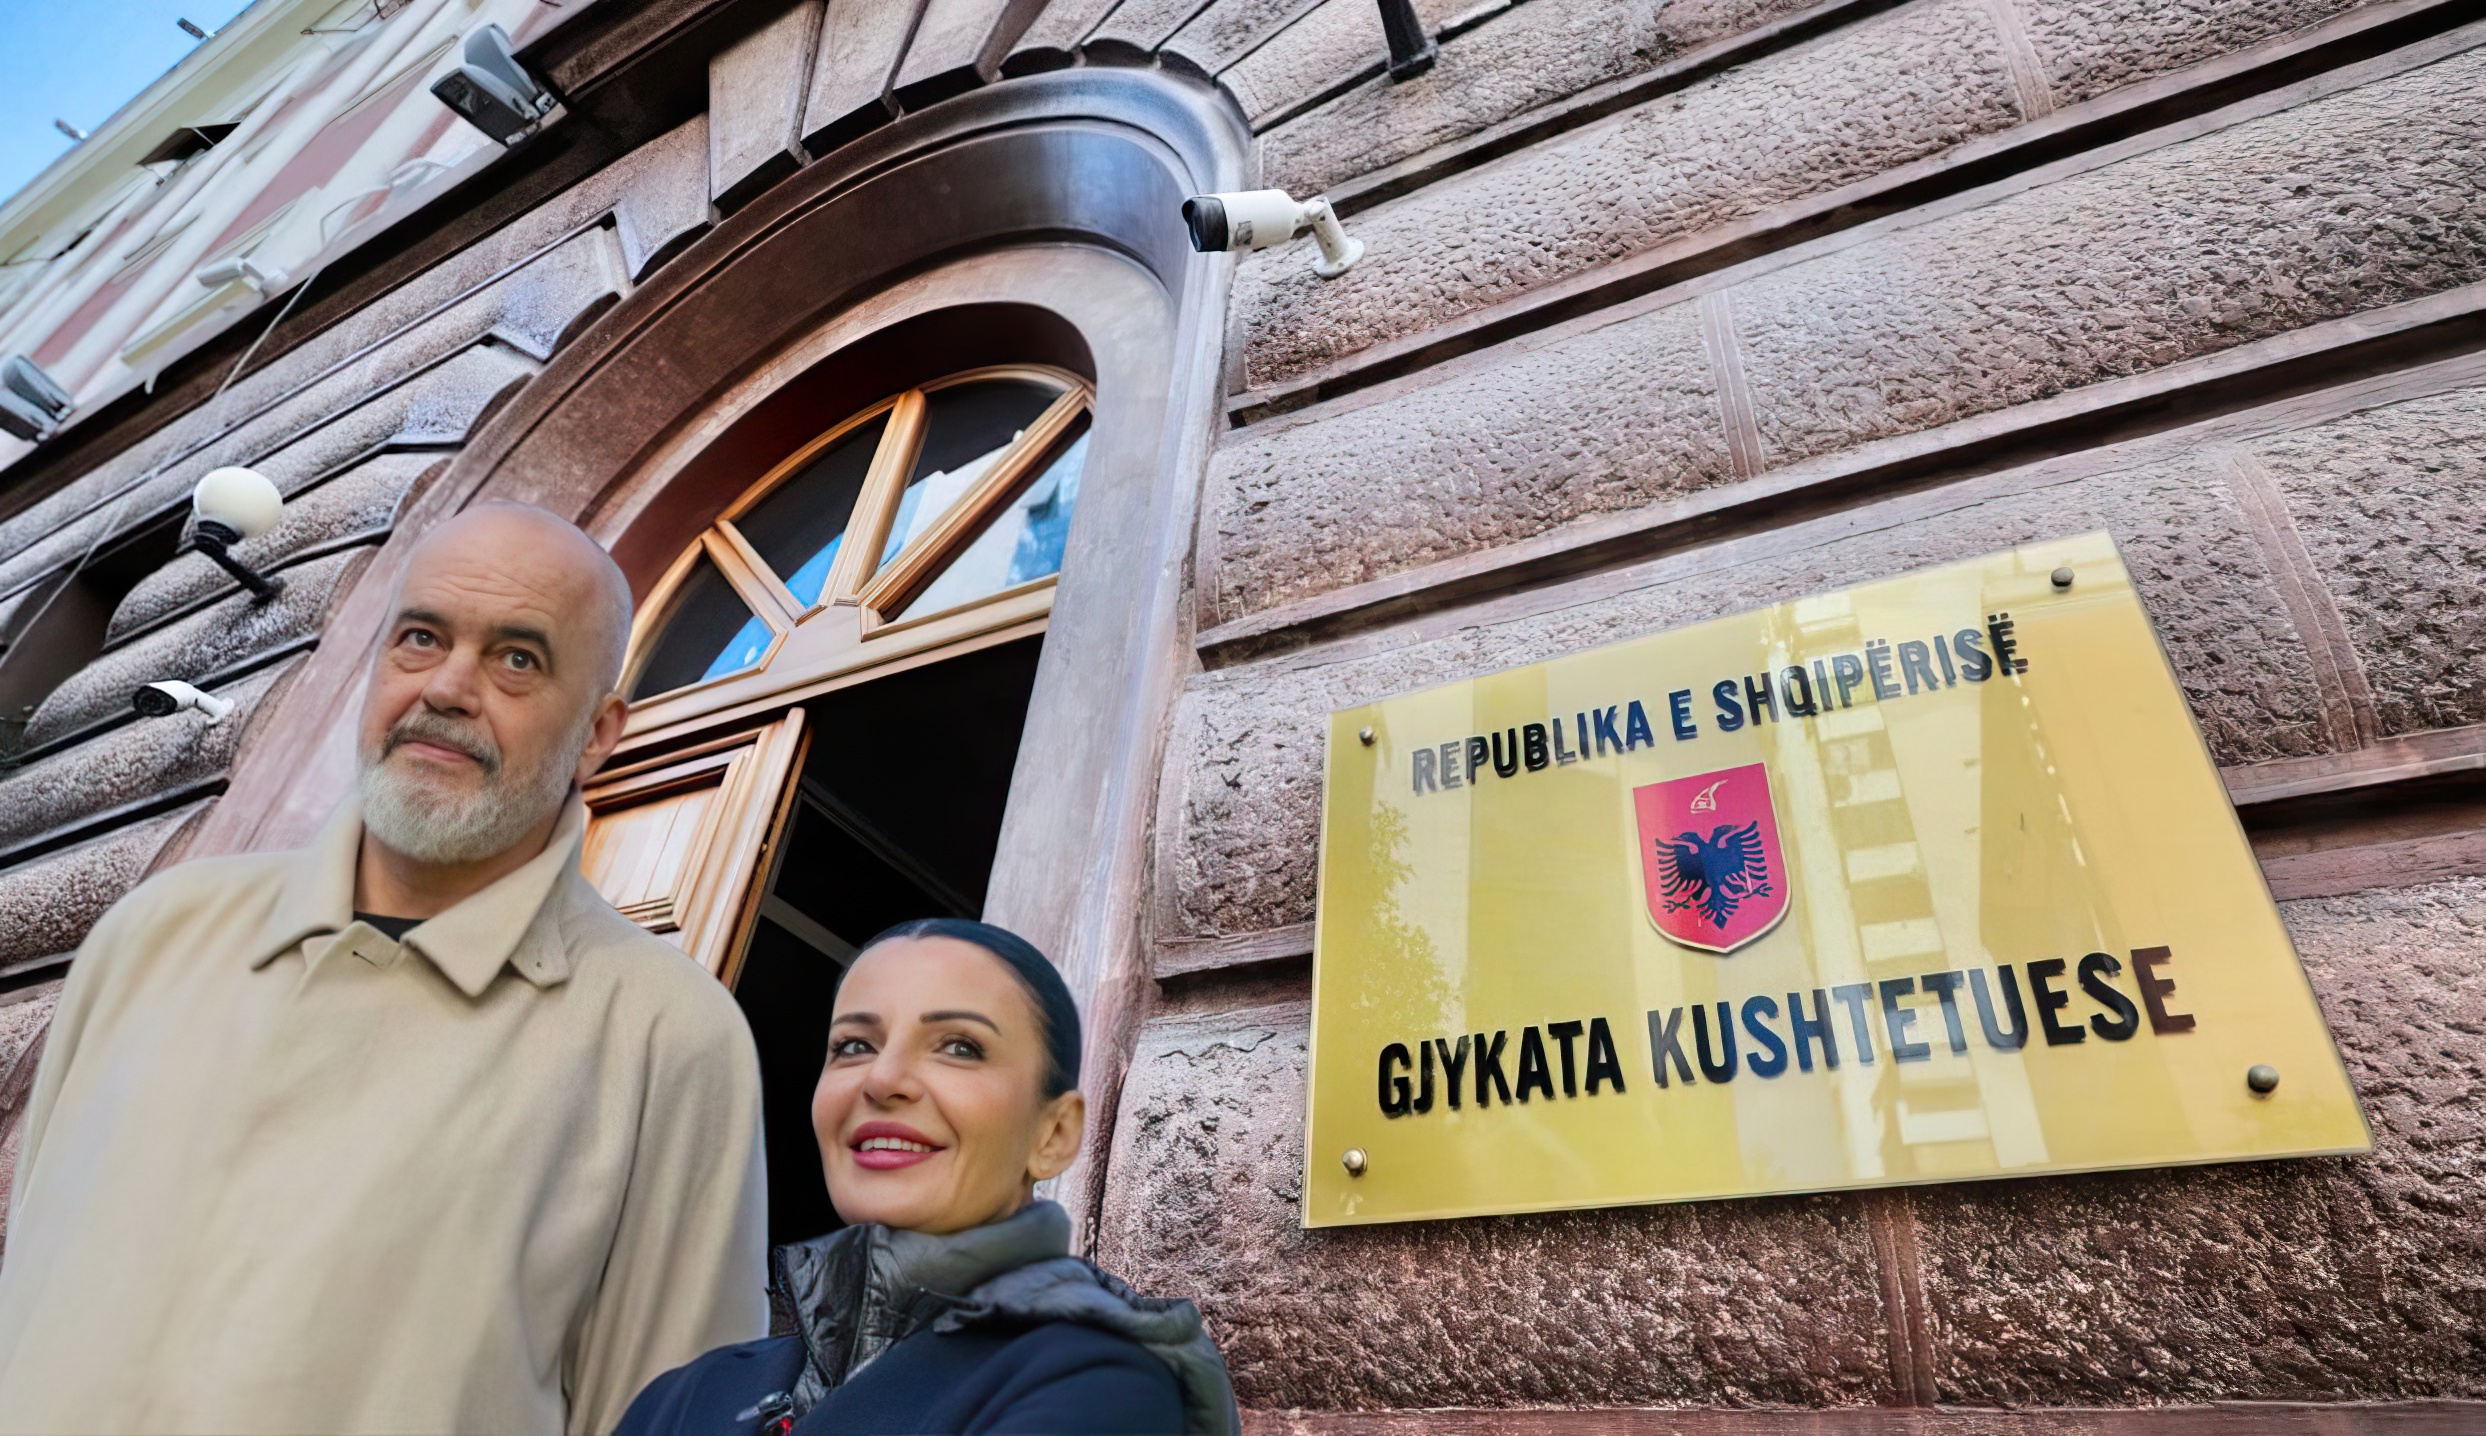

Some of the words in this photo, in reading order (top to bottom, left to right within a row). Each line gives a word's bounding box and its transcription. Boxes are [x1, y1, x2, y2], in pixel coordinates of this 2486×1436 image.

[1412, 699, 1655, 796] REPUBLIKA
[1669, 688, 1698, 741] E
[1714, 613, 2029, 733] SHQIPËRISË
[1377, 1017, 1627, 1120] GJYKATA
[1649, 945, 2196, 1088] KUSHTETUESE
